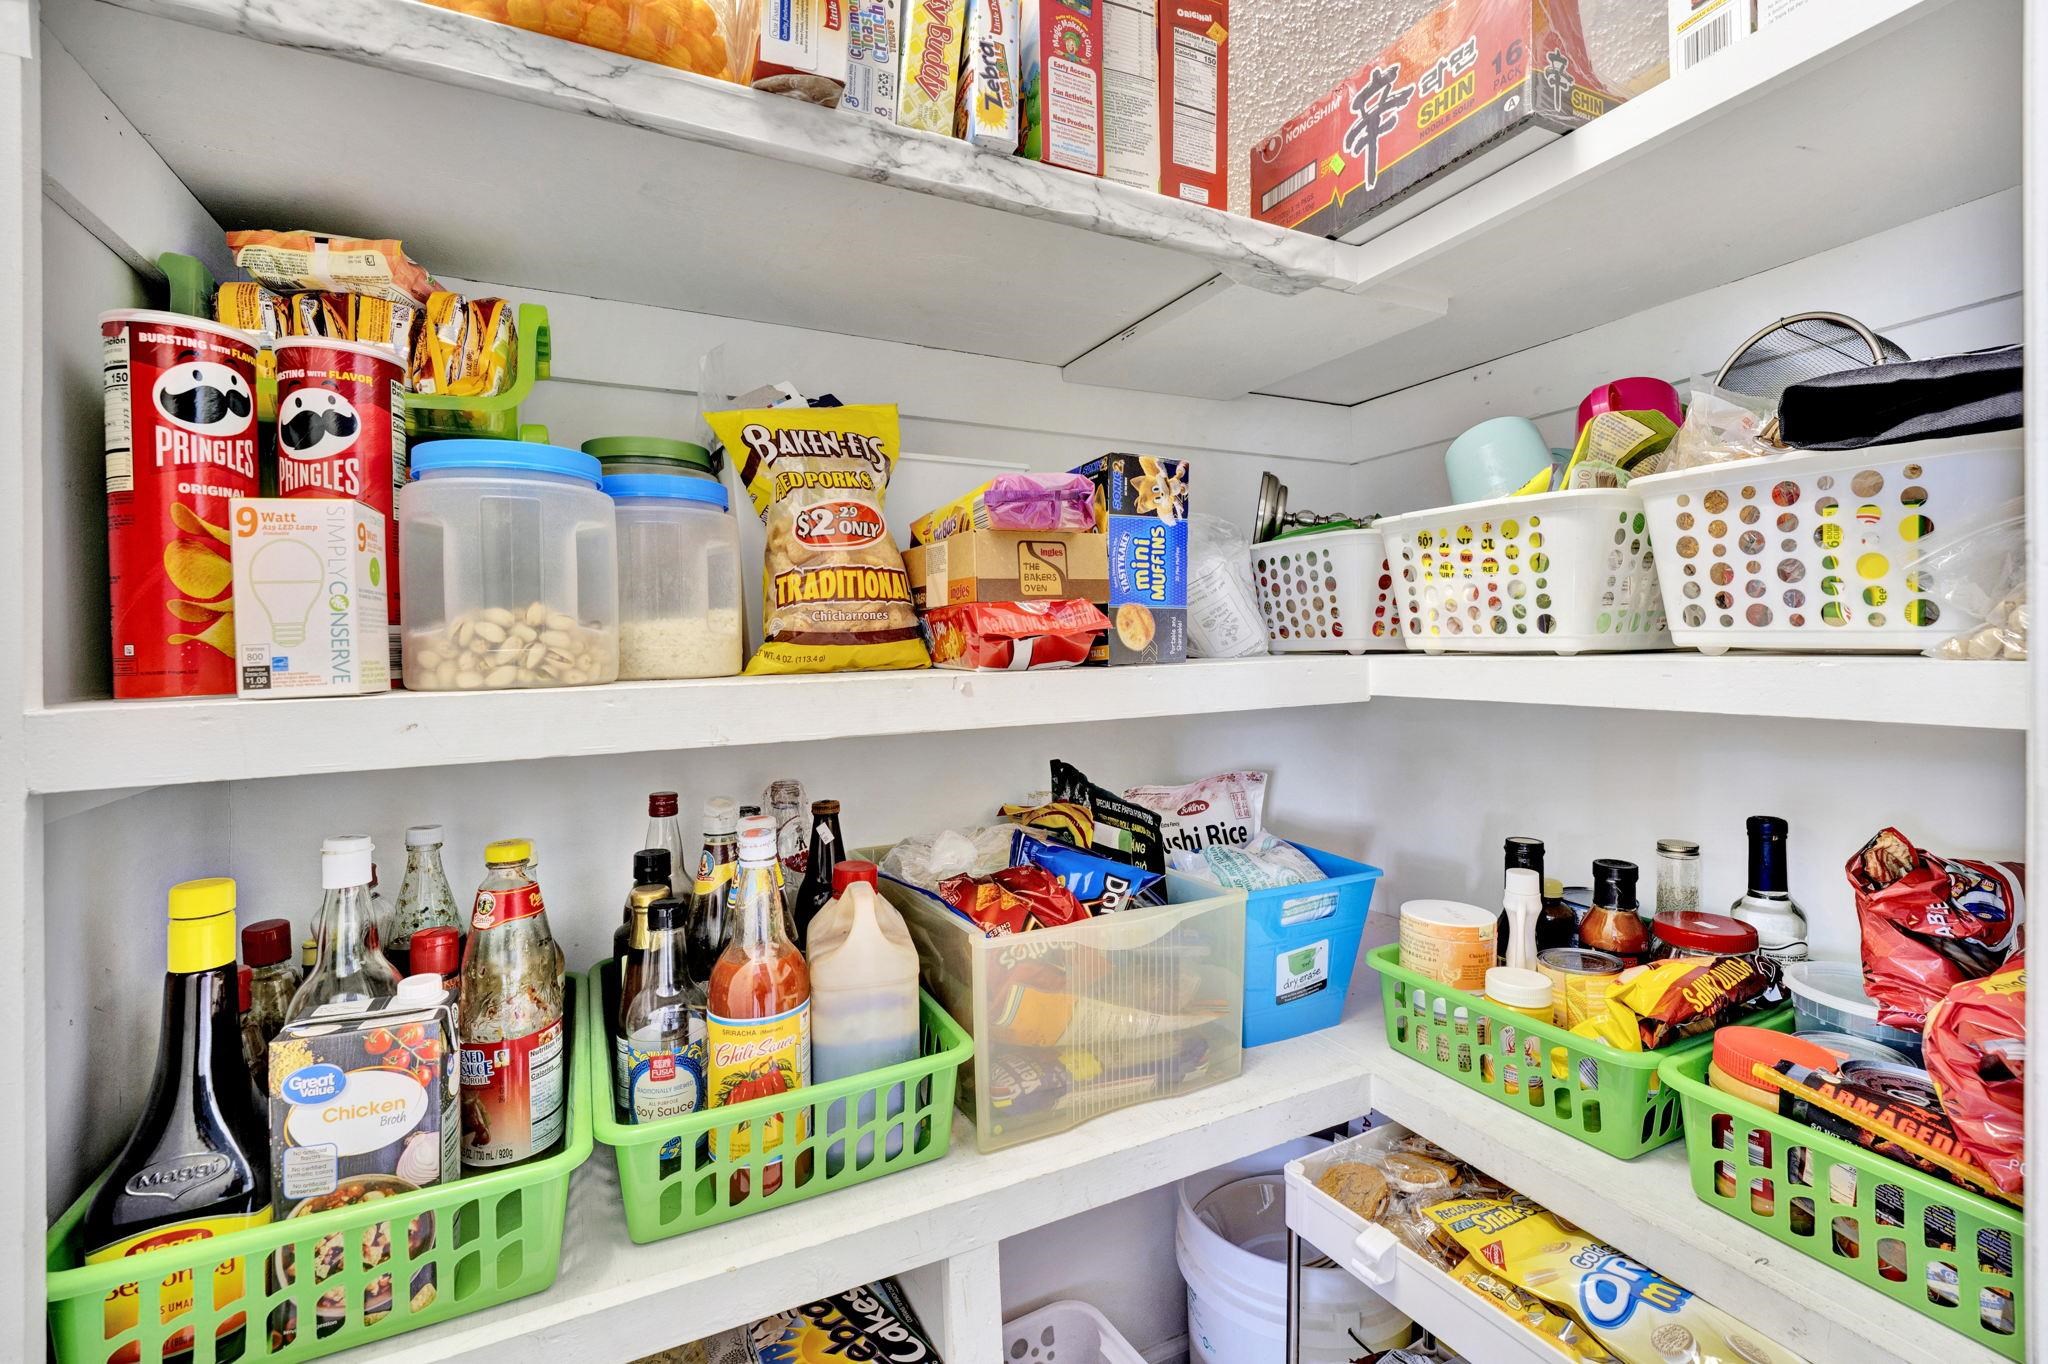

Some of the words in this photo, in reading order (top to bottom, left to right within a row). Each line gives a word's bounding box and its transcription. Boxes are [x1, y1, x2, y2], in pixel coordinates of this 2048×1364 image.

[869, 4, 888, 61] Crunch
[915, 23, 953, 102] Buddy
[1491, 38, 1523, 75] 16
[979, 41, 1004, 110] Zebra
[1493, 66, 1523, 91] PACK
[1419, 73, 1474, 126] SHIN
[1572, 90, 1603, 115] SHIN
[1284, 95, 1343, 144] NONGSHIM
[1343, 63, 1416, 191] 辛
[1418, 117, 1450, 140] NOODLE
[1452, 98, 1476, 117] SOUP
[138, 332, 207, 350] BURSTING
[209, 344, 231, 355] WITH
[231, 348, 257, 367] FLAVO
[111, 372, 129, 383] 150
[307, 370, 327, 379] WITH
[328, 370, 374, 387] FLAVOR
[155, 425, 254, 479] PRINGLES
[741, 424, 885, 472] BAKEN-ETS
[279, 456, 360, 497] PRINGLES
[804, 472, 860, 490] PORK
[235, 506, 259, 538] 9
[260, 512, 297, 523] Watt
[357, 521, 367, 552] 9
[838, 521, 881, 538] ONLY
[1023, 562, 1040, 571] THE
[1040, 547, 1064, 558] ingles
[1117, 532, 1131, 593] TASTYKAKE
[1131, 537, 1151, 591] mini
[1151, 526, 1167, 602] MUFFINS
[775, 569, 912, 606] TRADITIONAL
[1024, 573, 1057, 582] BAKERS
[1024, 584, 1048, 592] OVEN
[811, 610, 889, 622] Chicharrones
[246, 652, 264, 661] 800
[245, 677, 268, 685] $1.08
[1162, 826, 1202, 855] ushi
[1205, 821, 1248, 846] Rice
[1299, 967, 1321, 983] erase
[721, 1026, 756, 1038] SRIRACHA
[716, 1041, 753, 1068] Chili
[753, 1036, 797, 1057] Sauce
[289, 1073, 335, 1091] Great
[651, 1067, 675, 1078] FUSIA
[301, 1085, 336, 1098] Value
[322, 1098, 407, 1123] Chicken
[380, 1112, 407, 1127] Broth
[636, 1105, 654, 1120] Soy
[657, 1101, 695, 1117] Sauce
[499, 1149, 513, 1160] 920g
[134, 1158, 220, 1191] Maggi
[800, 1299, 880, 1362] ebra
[841, 1286, 927, 1363] Cakes
